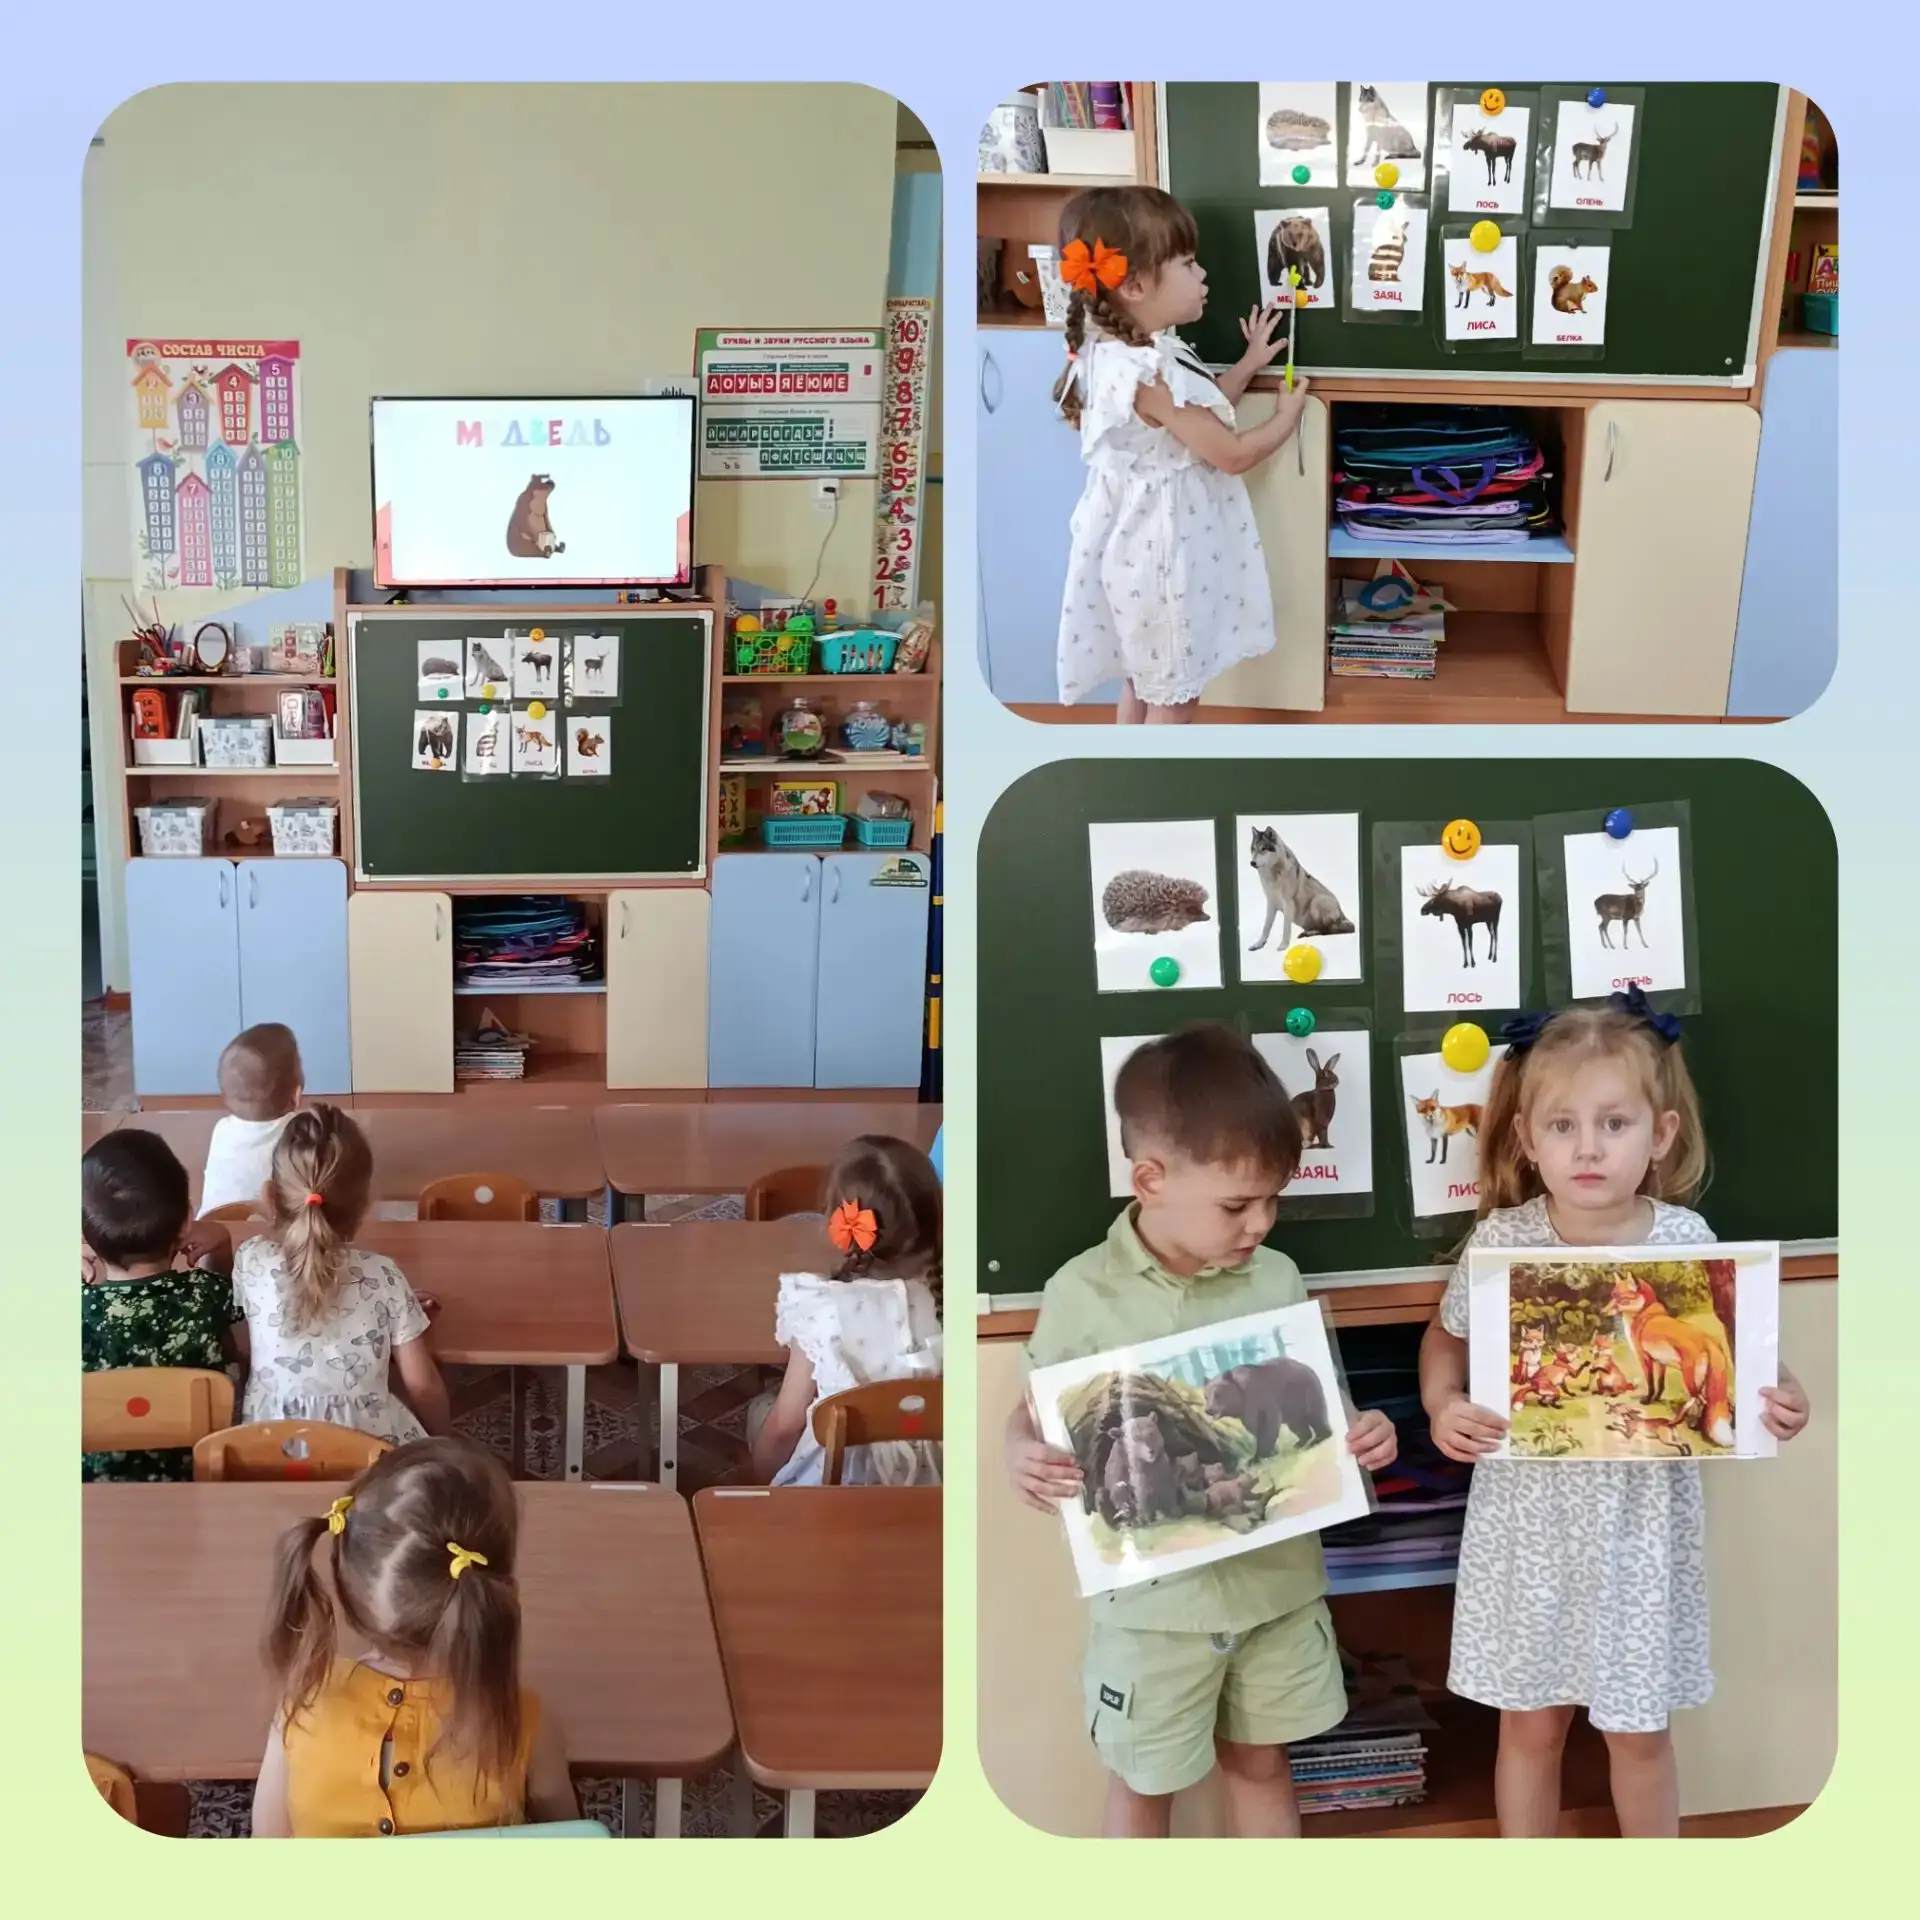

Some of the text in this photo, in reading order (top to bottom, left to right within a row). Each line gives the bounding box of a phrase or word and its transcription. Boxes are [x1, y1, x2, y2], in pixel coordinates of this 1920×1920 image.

[1476, 200, 1499, 209] ЛОСЬ
[1576, 197, 1603, 206] ОЛЕНЬ
[1276, 294, 1319, 304] МЕДЬ
[1373, 290, 1402, 302] ЗАЯЦ
[896, 320, 919, 343] 10
[1467, 321, 1496, 330] ЛИСА
[722, 335, 869, 345] БУКВЫ И ЗВУКИ РУССКОГО ЯЗЫКА
[162, 344, 212, 356] СОСТАВ
[216, 344, 266, 357] ЧИСЛА
[896, 347, 914, 374] 9
[271, 364, 280, 375] 5
[229, 376, 238, 387] 4
[189, 393, 197, 404] 3
[896, 381, 912, 404] 8
[895, 407, 912, 430] 7
[456, 418, 611, 447] МДВЕДЬ
[282, 449, 292, 459] 10
[892, 441, 909, 464] 6
[153, 462, 162, 474] 6
[249, 457, 257, 469] 9
[890, 467, 907, 491] 5
[188, 483, 197, 494] 7
[889, 497, 904, 518] 4
[896, 528, 912, 551] 3
[875, 557, 891, 580] 2
[873, 585, 885, 609] 1
[1447, 992, 1482, 1004] ЛОСЬ
[1448, 1182, 1480, 1198] ЛИС
